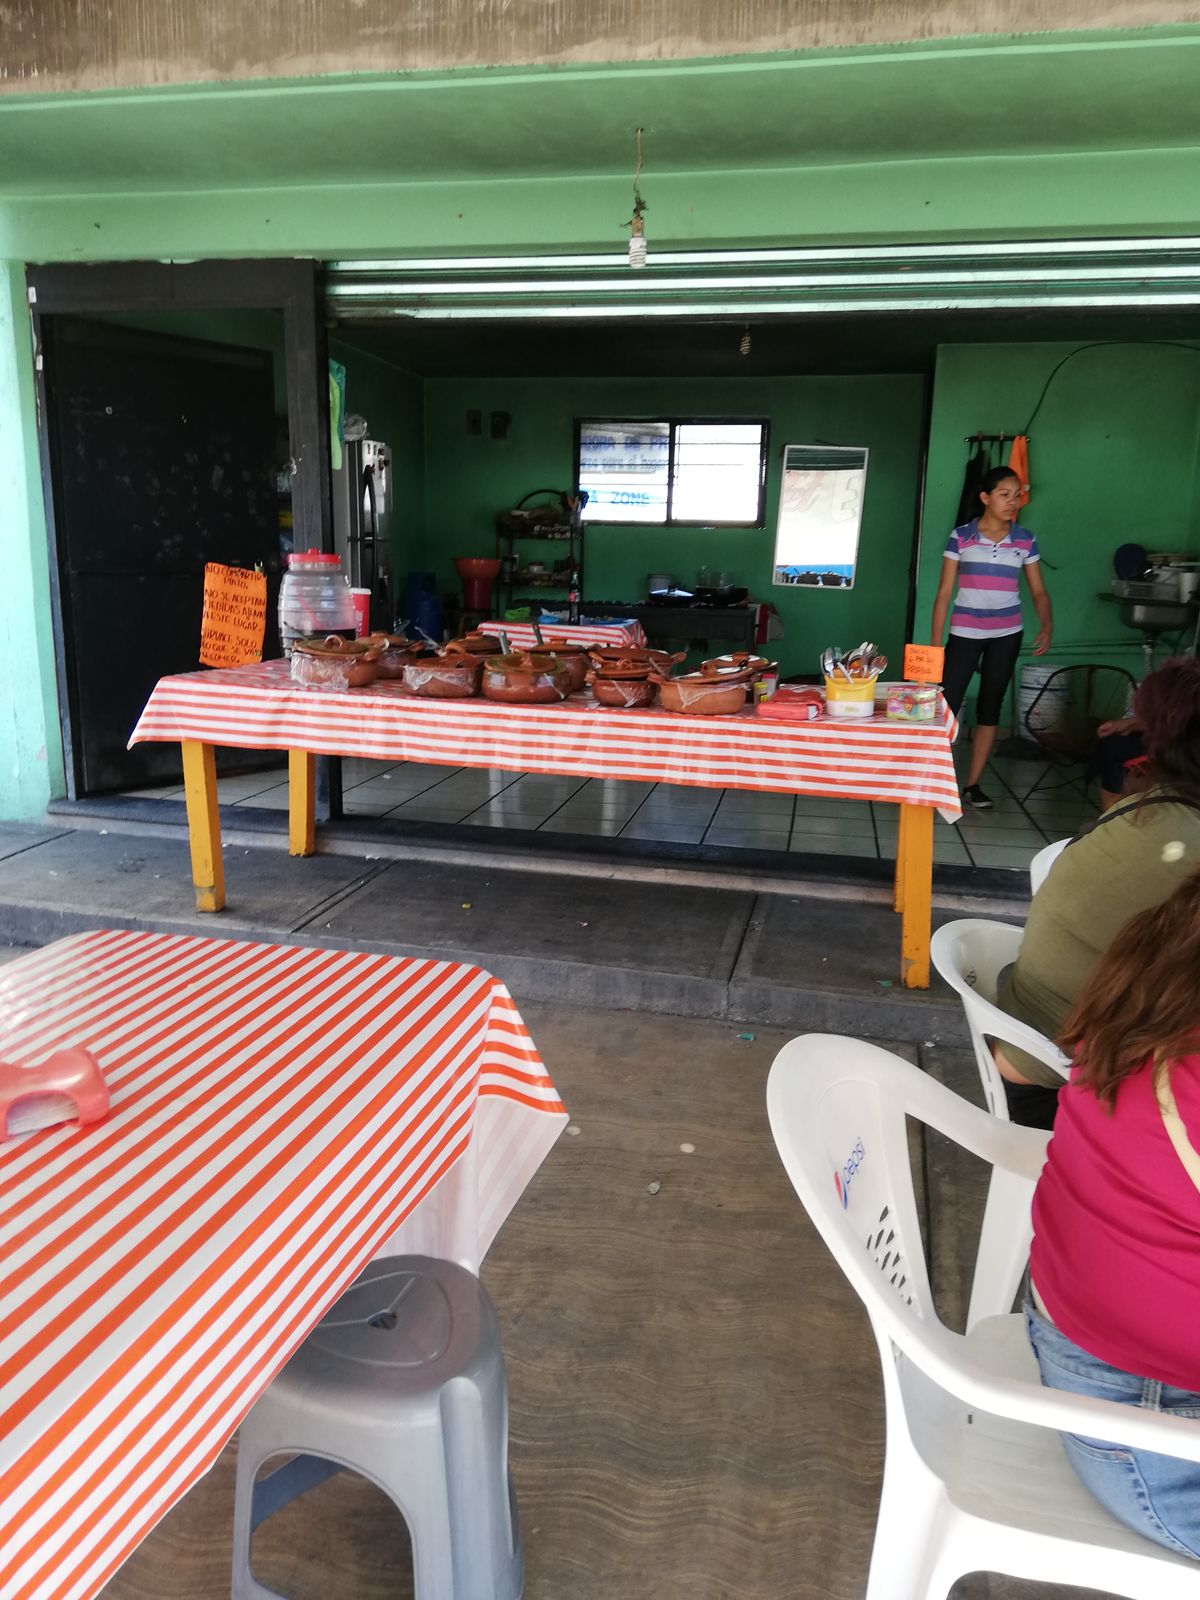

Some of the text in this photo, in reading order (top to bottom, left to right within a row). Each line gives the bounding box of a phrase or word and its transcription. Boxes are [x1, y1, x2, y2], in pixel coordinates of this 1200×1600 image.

[204, 588, 218, 599] NO
[236, 635, 257, 648] SOLO
[841, 1136, 865, 1190] pepsi
